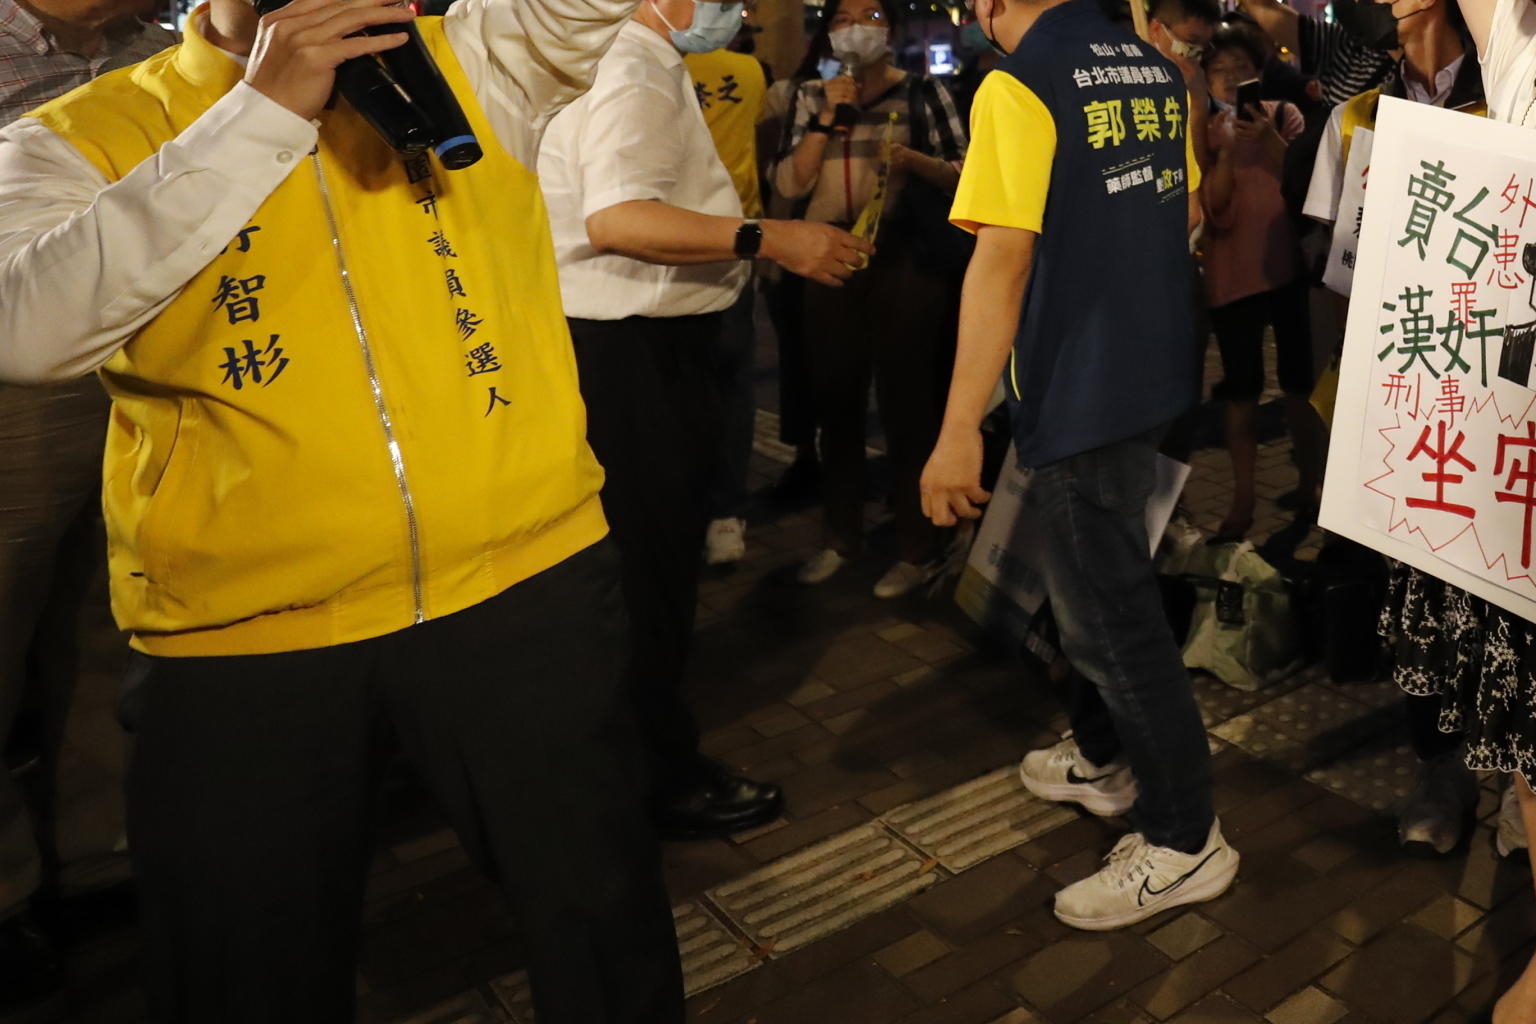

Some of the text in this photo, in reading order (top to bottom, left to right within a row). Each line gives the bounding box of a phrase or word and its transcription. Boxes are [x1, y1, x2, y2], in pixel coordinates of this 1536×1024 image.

[1397, 159, 1500, 280] 賣台
[1377, 284, 1505, 388] 漢奸
[1382, 372, 1466, 432] 刑事
